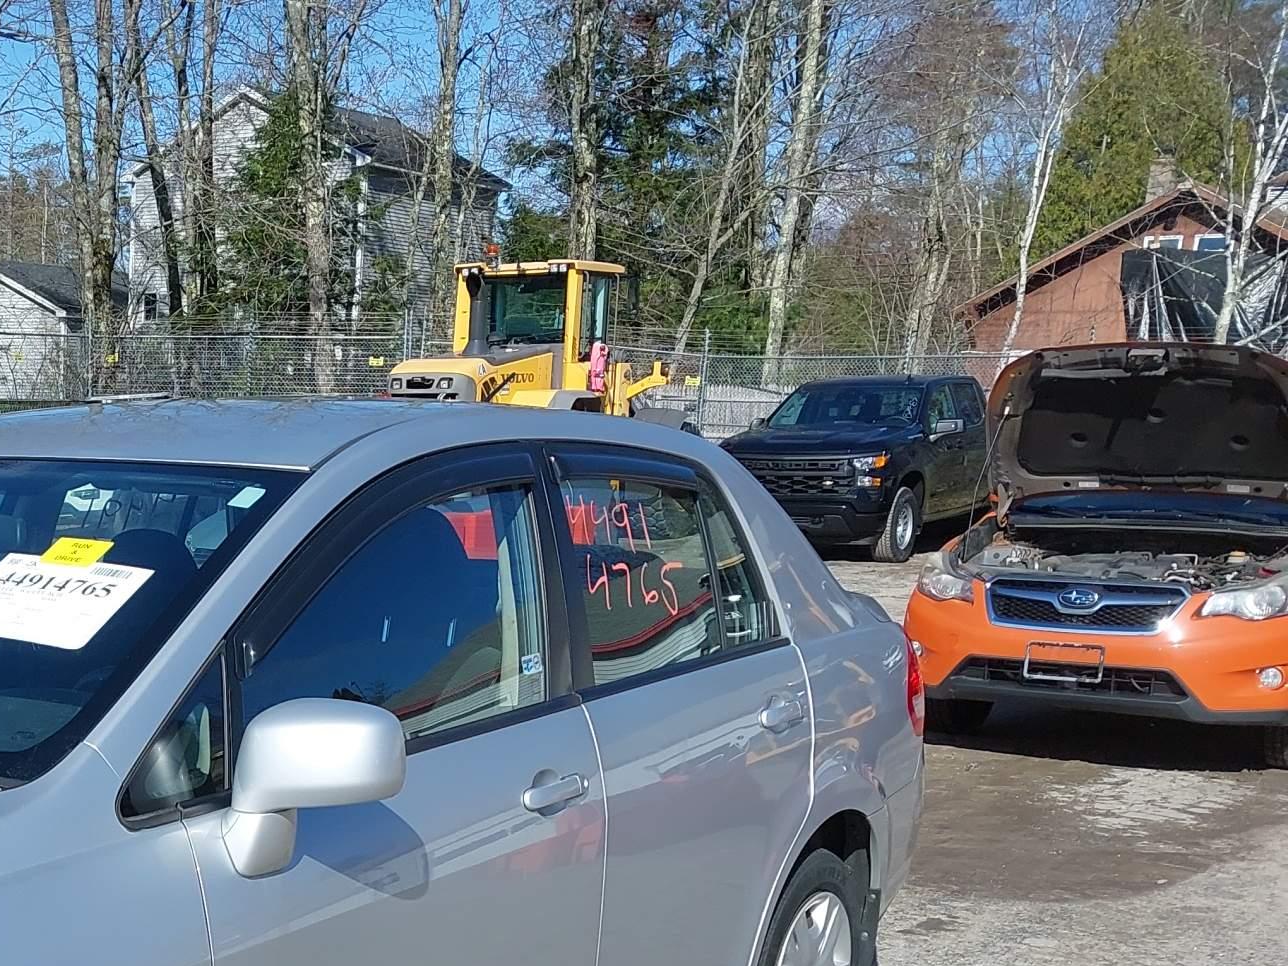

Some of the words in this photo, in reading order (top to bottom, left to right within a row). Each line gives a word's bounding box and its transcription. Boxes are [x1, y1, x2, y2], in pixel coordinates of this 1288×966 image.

[501, 372, 535, 384] VOLVO
[565, 494, 651, 554] 4491
[587, 553, 683, 616] 4765
